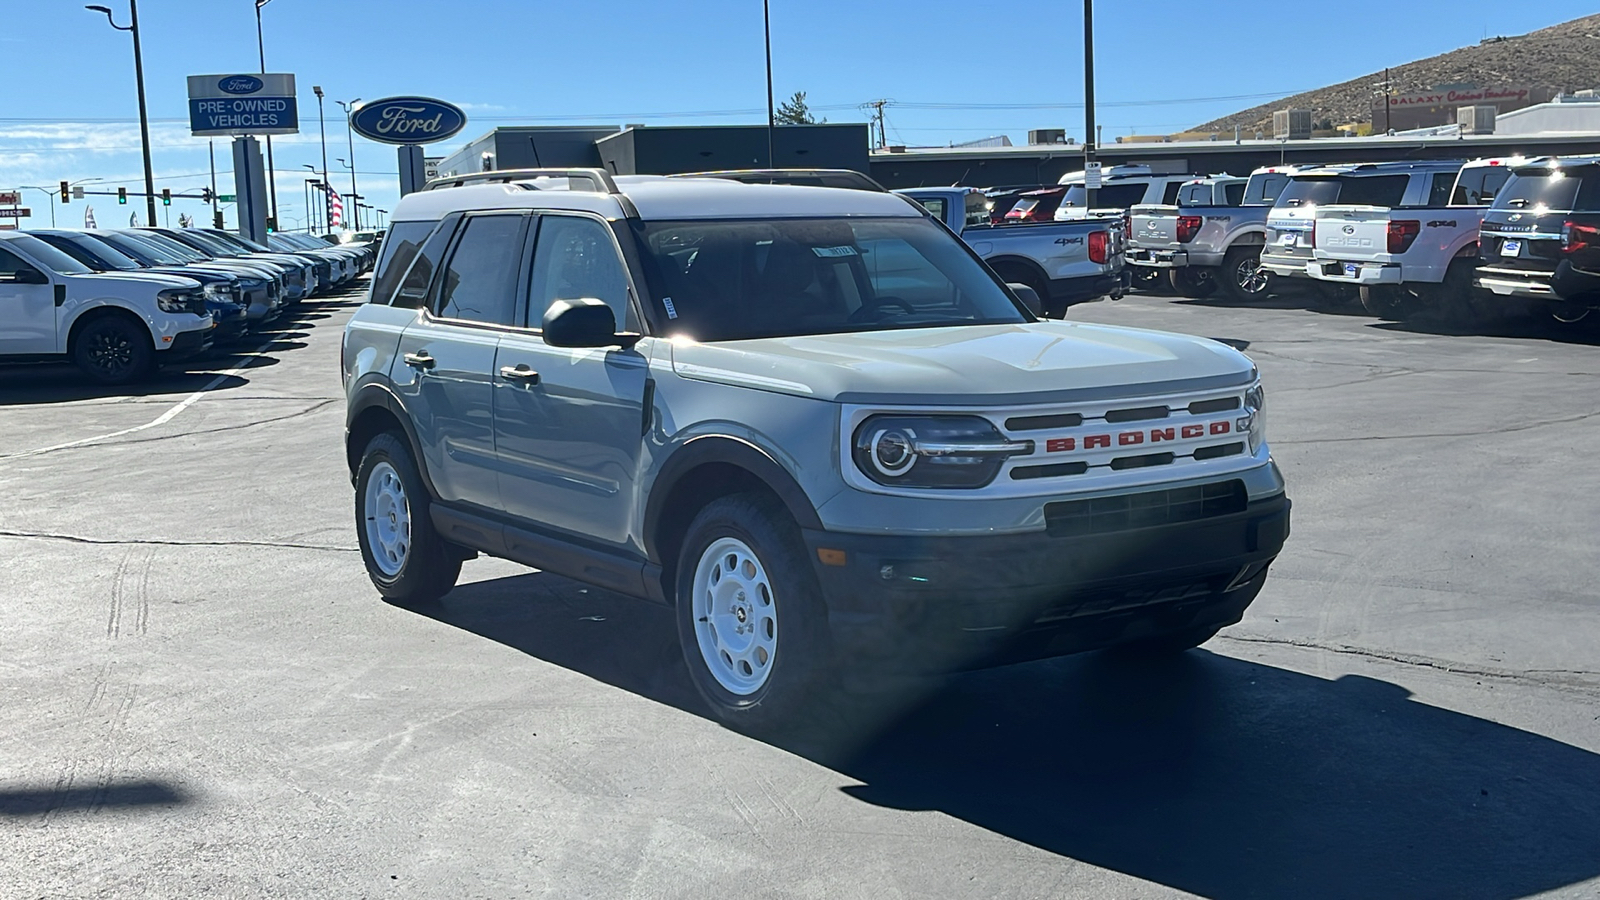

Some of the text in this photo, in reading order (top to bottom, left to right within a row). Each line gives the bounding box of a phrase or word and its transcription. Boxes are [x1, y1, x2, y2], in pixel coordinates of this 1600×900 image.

[227, 79, 254, 91] Ford
[1390, 94, 1444, 105] GALAXY
[198, 100, 287, 113] PRE-OWNED
[209, 114, 278, 126] VEHICLES
[376, 106, 443, 133] Ford
[1326, 237, 1374, 247] F-150
[1046, 421, 1230, 452] BRONCO
